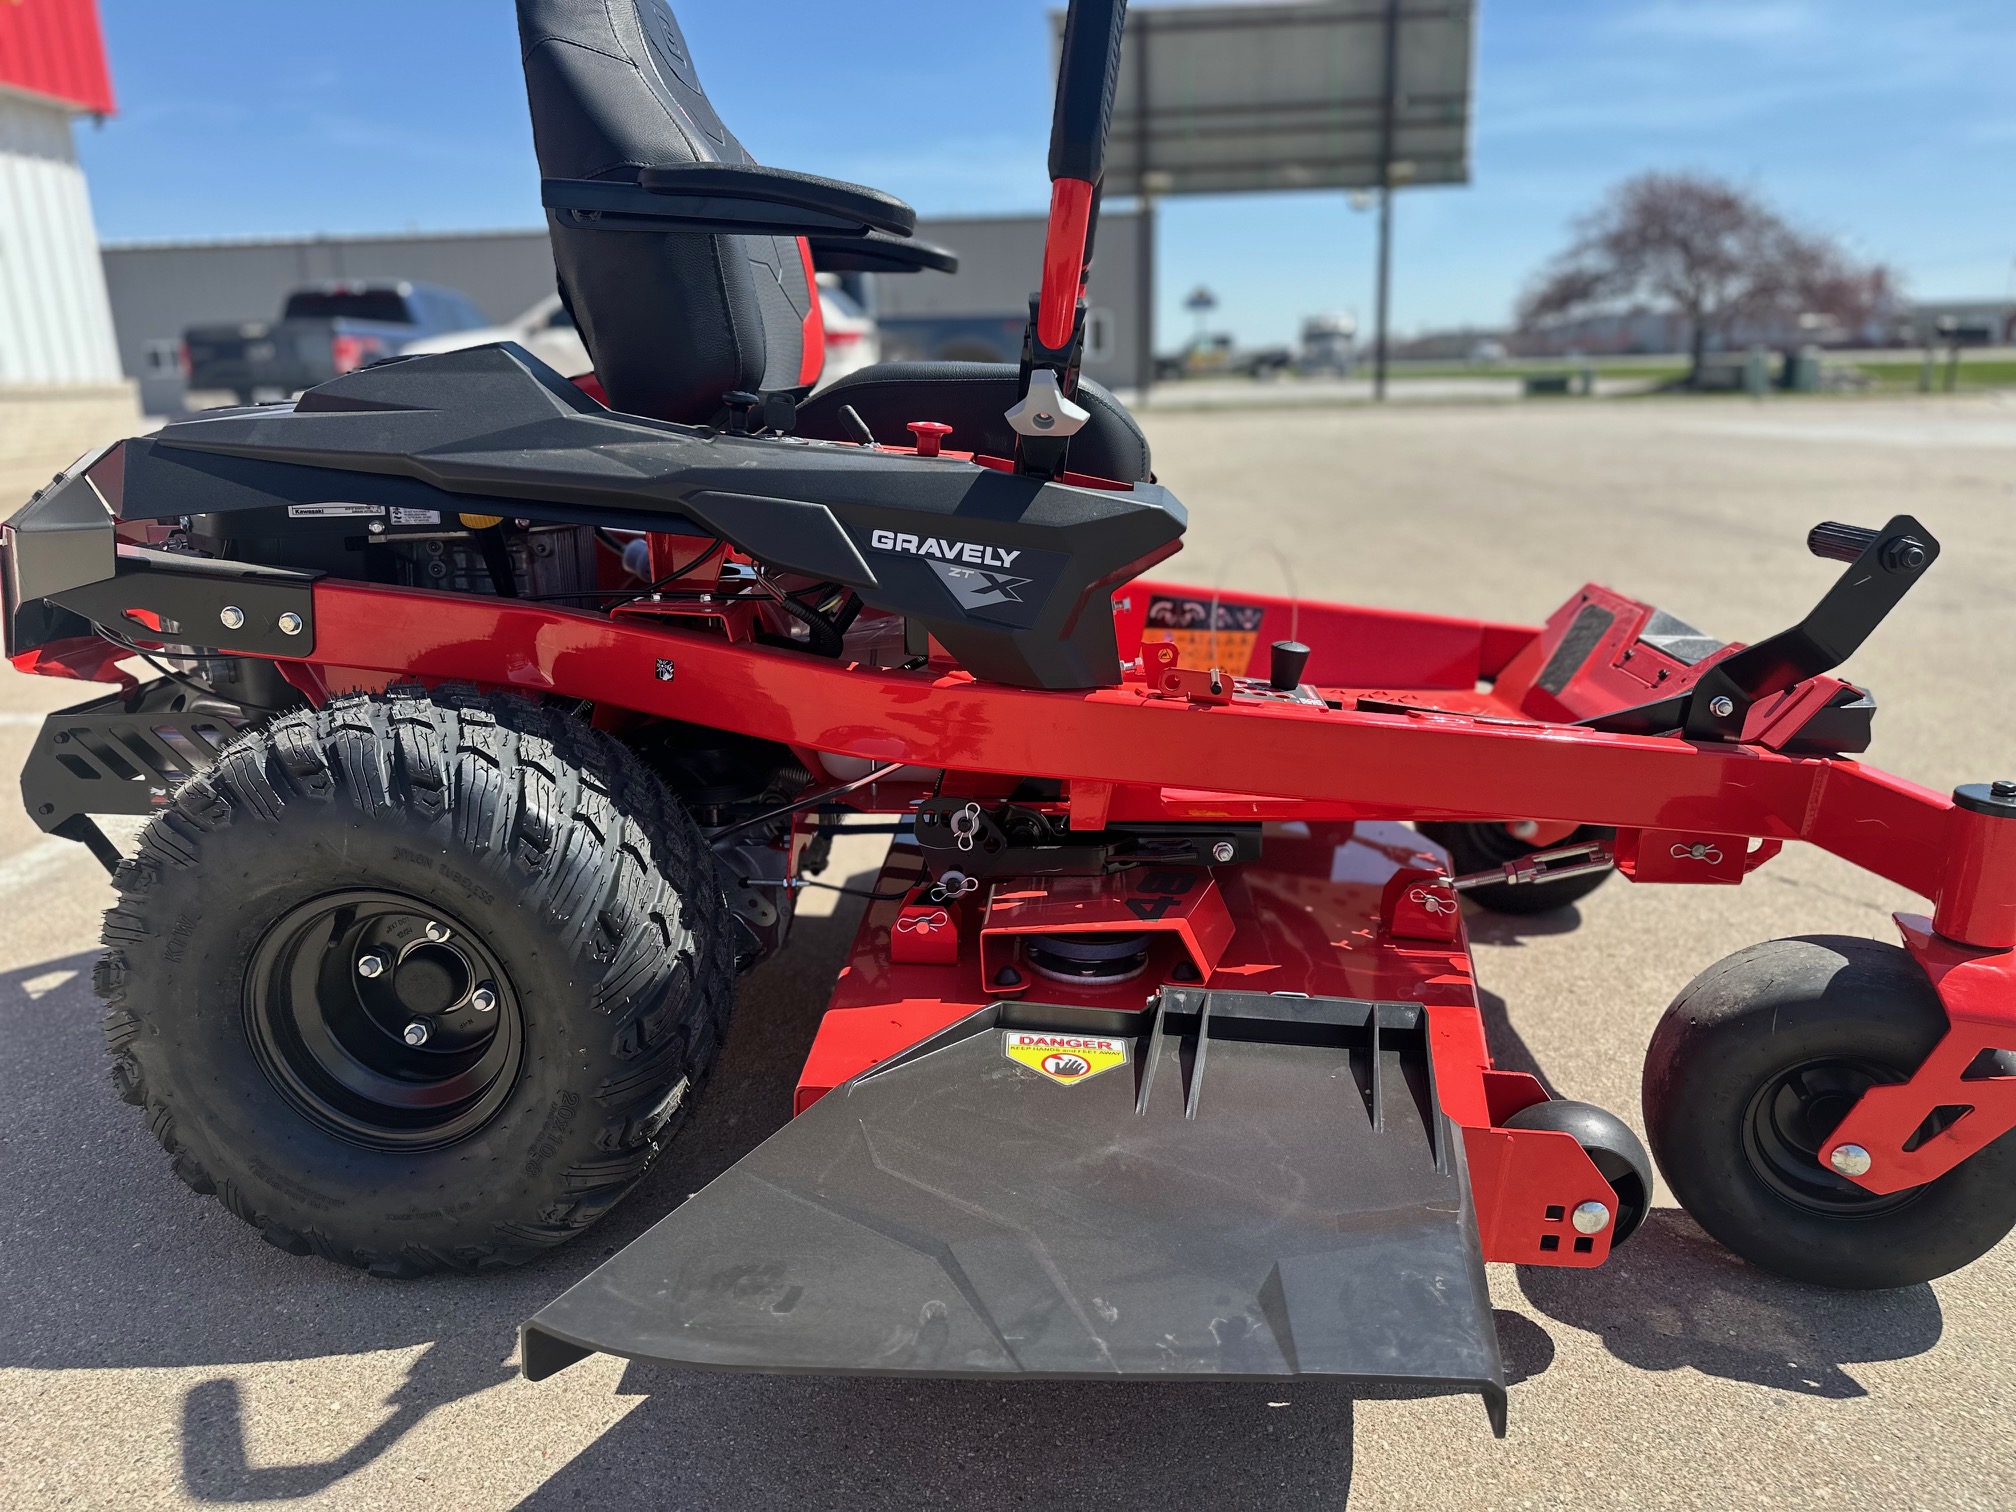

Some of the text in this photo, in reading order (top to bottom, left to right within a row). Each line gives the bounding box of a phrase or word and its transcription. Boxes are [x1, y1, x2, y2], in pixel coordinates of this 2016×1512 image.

[871, 529, 1022, 568] GRAVELY
[948, 567, 975, 579] ZT
[1019, 1036, 1114, 1051] DANGER
